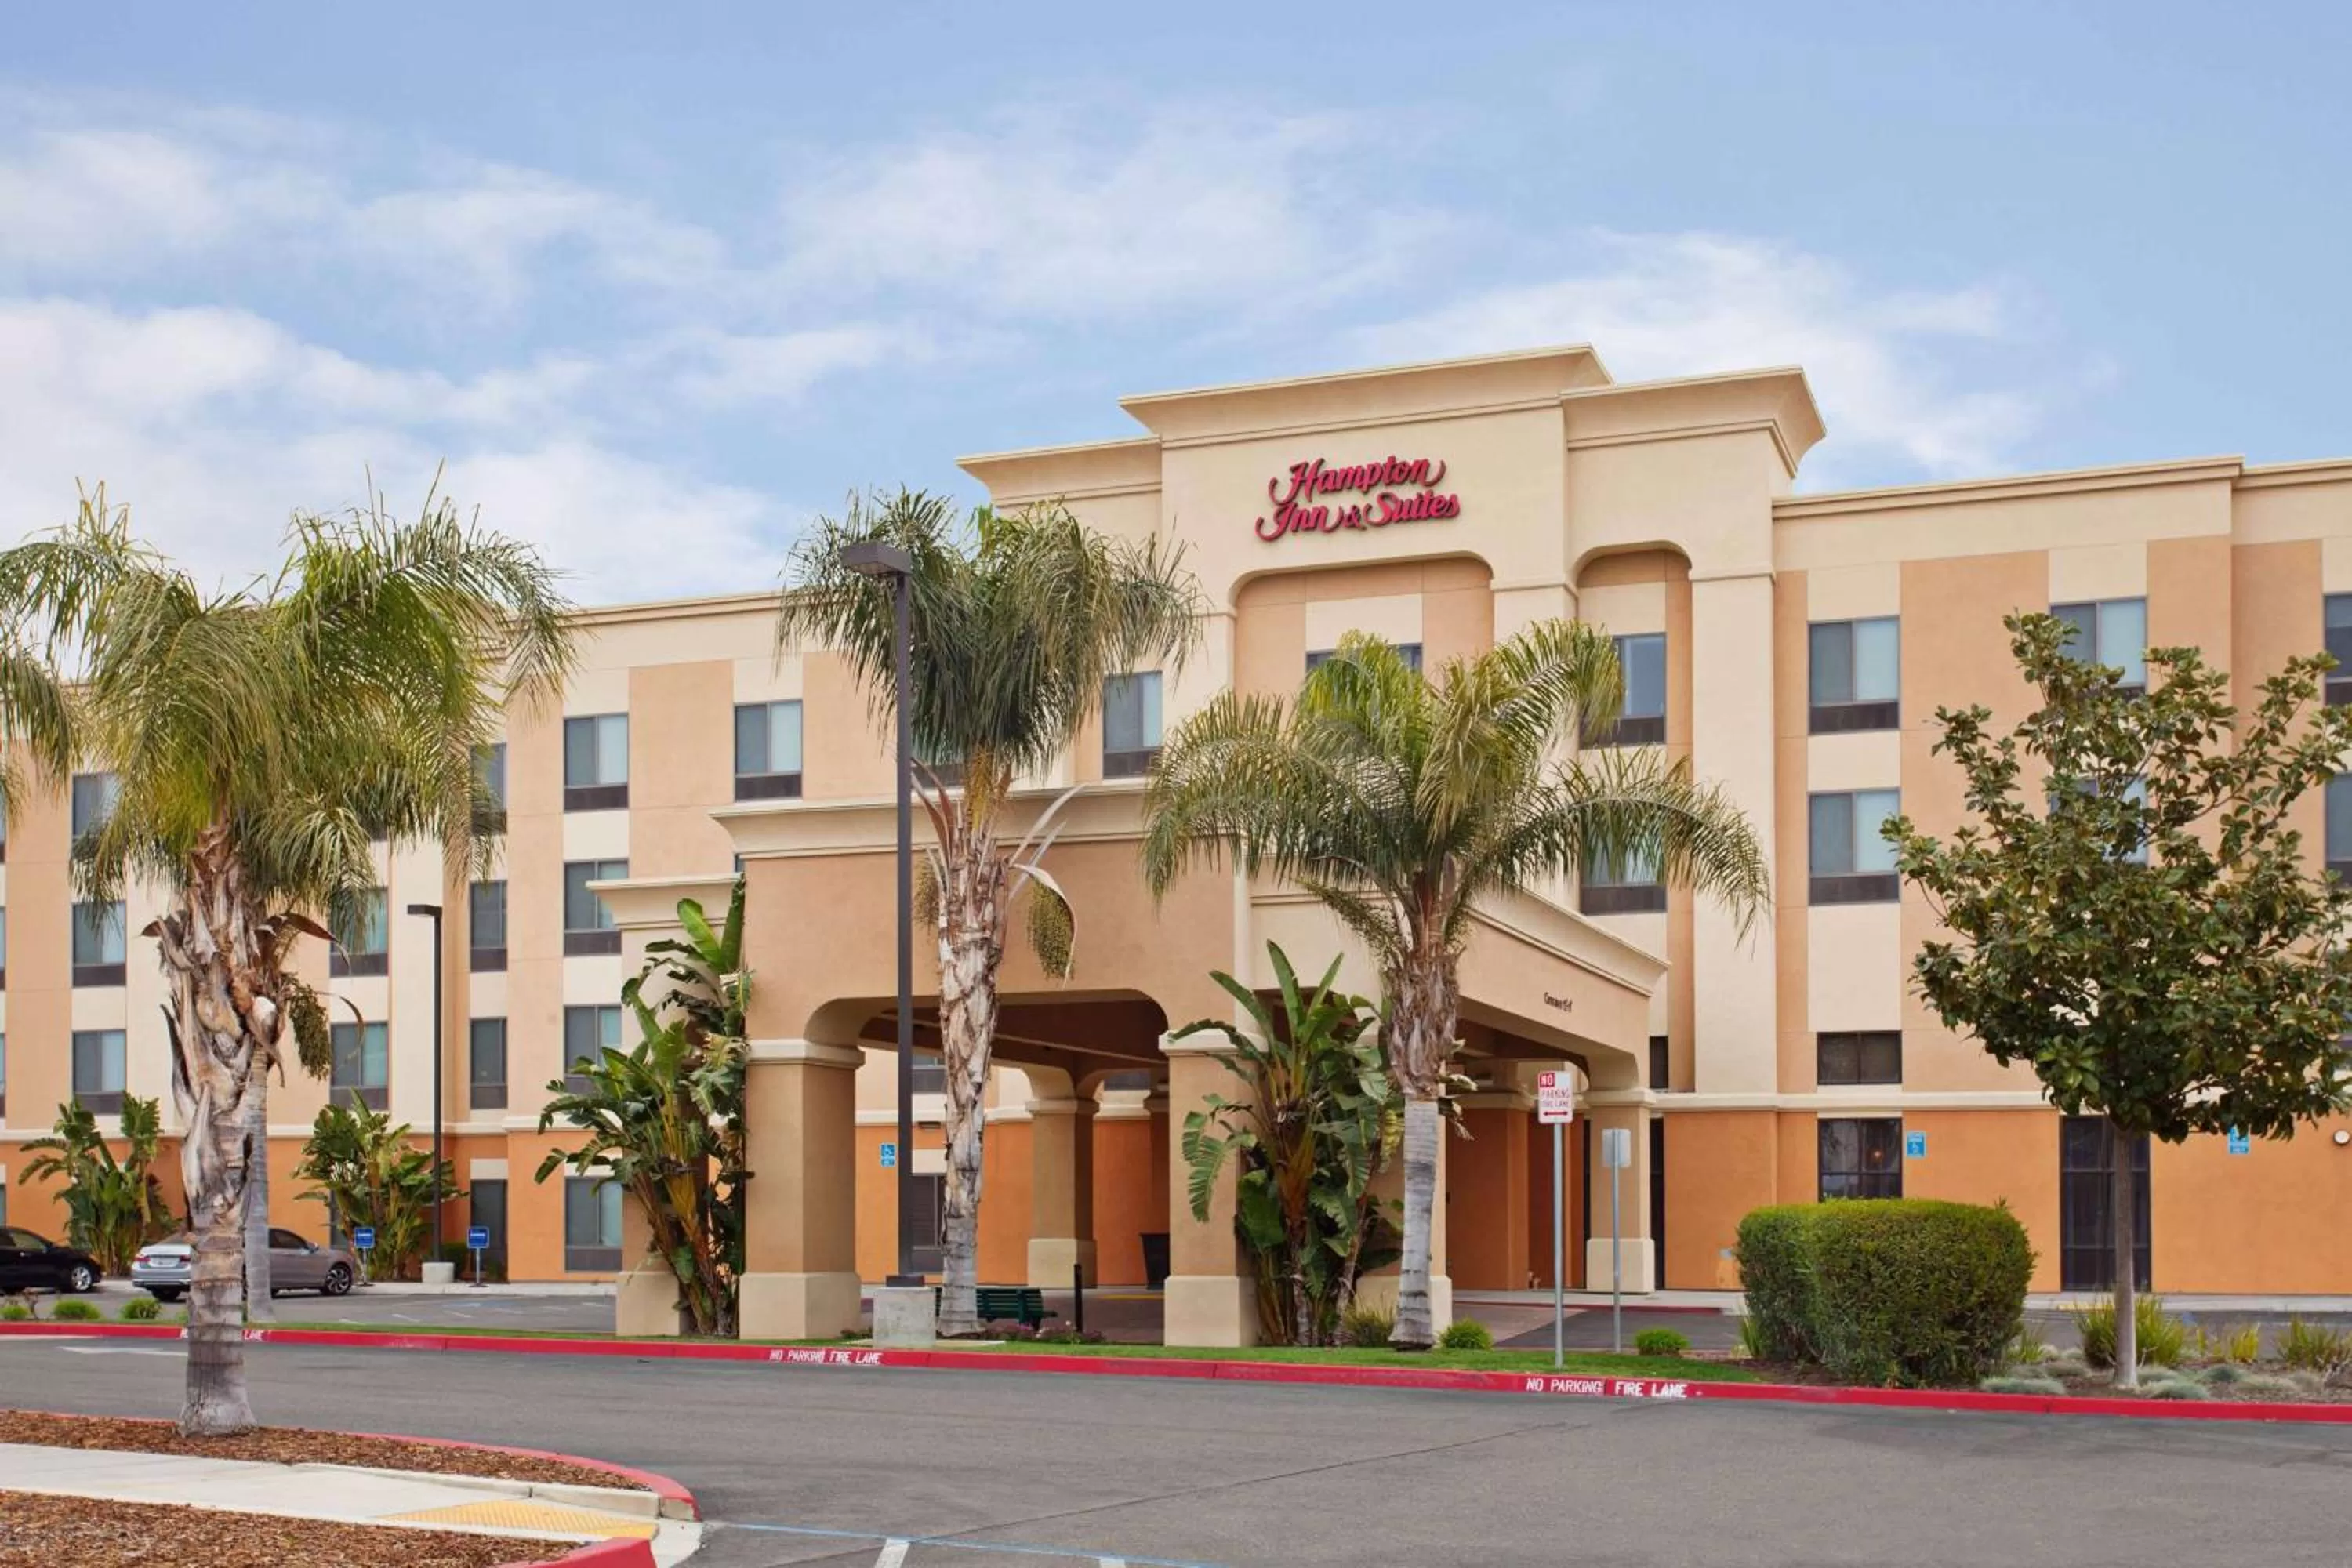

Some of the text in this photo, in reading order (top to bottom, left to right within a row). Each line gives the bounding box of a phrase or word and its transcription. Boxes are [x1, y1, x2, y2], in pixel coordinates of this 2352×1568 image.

[1268, 455, 1447, 506] Hampton
[1254, 490, 1461, 543] Inn & Suites
[1541, 1074, 1553, 1086] NO
[769, 1349, 783, 1361] NO
[829, 1351, 851, 1364] FIRE
[855, 1352, 884, 1365] LANE
[1526, 1378, 1688, 1398] NO PARKING FIRE LANE
